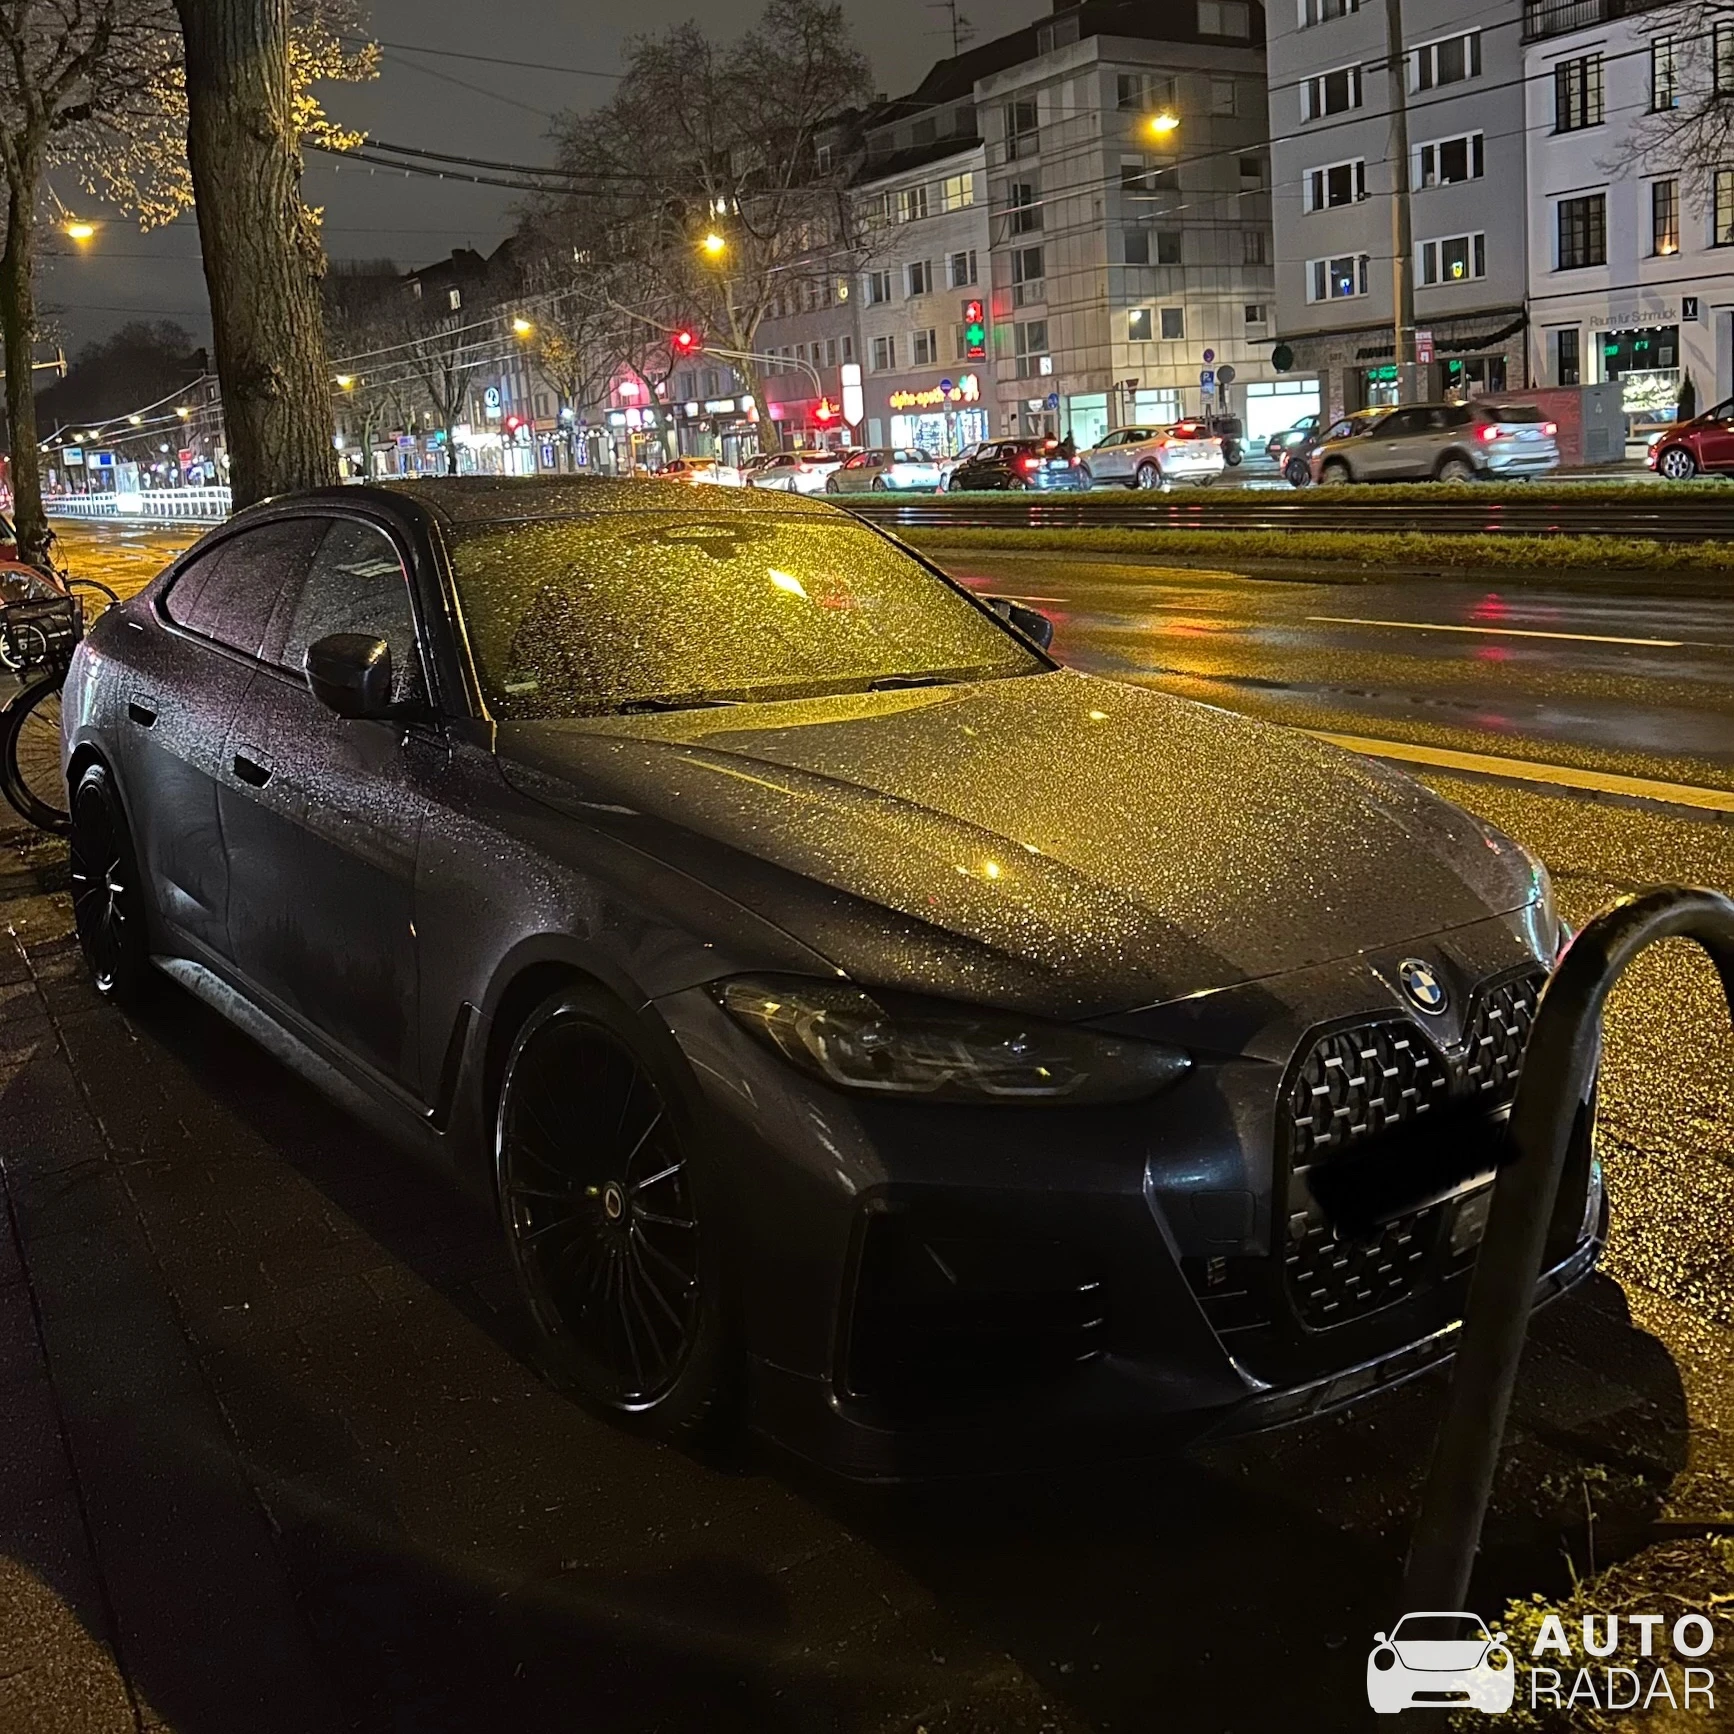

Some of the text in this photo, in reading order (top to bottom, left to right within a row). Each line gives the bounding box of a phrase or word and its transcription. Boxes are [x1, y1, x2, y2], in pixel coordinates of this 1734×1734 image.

[1590, 309, 1676, 326] Raum für Schmuck
